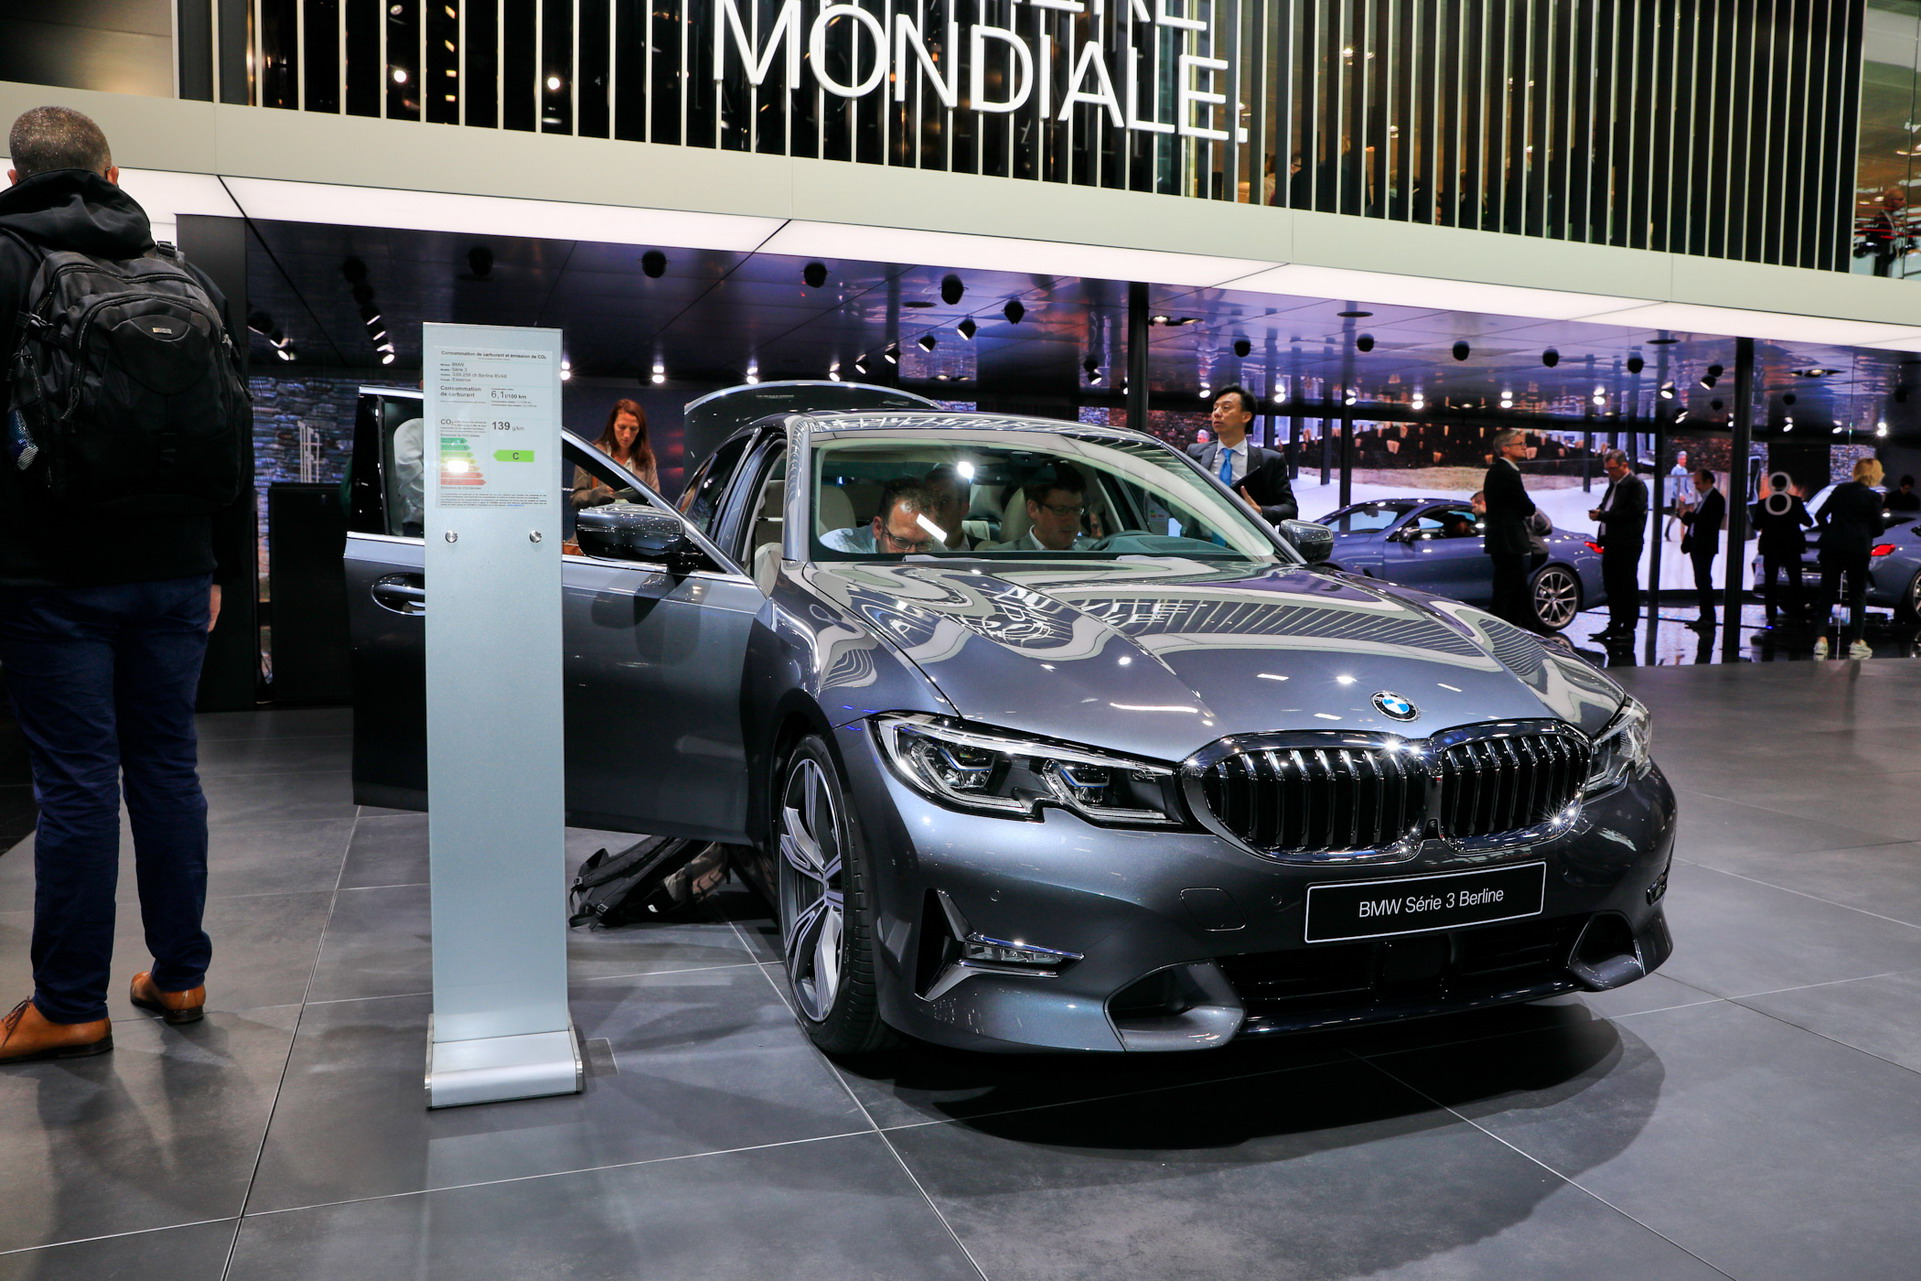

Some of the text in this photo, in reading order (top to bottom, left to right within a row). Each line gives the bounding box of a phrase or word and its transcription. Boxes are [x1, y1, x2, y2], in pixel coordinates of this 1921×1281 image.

[713, 0, 1247, 143] MONDIALE.
[492, 421, 511, 431] 139
[512, 452, 520, 460] C
[1765, 471, 1792, 516] 8
[1359, 888, 1504, 918] BMW Série 3 Berline
